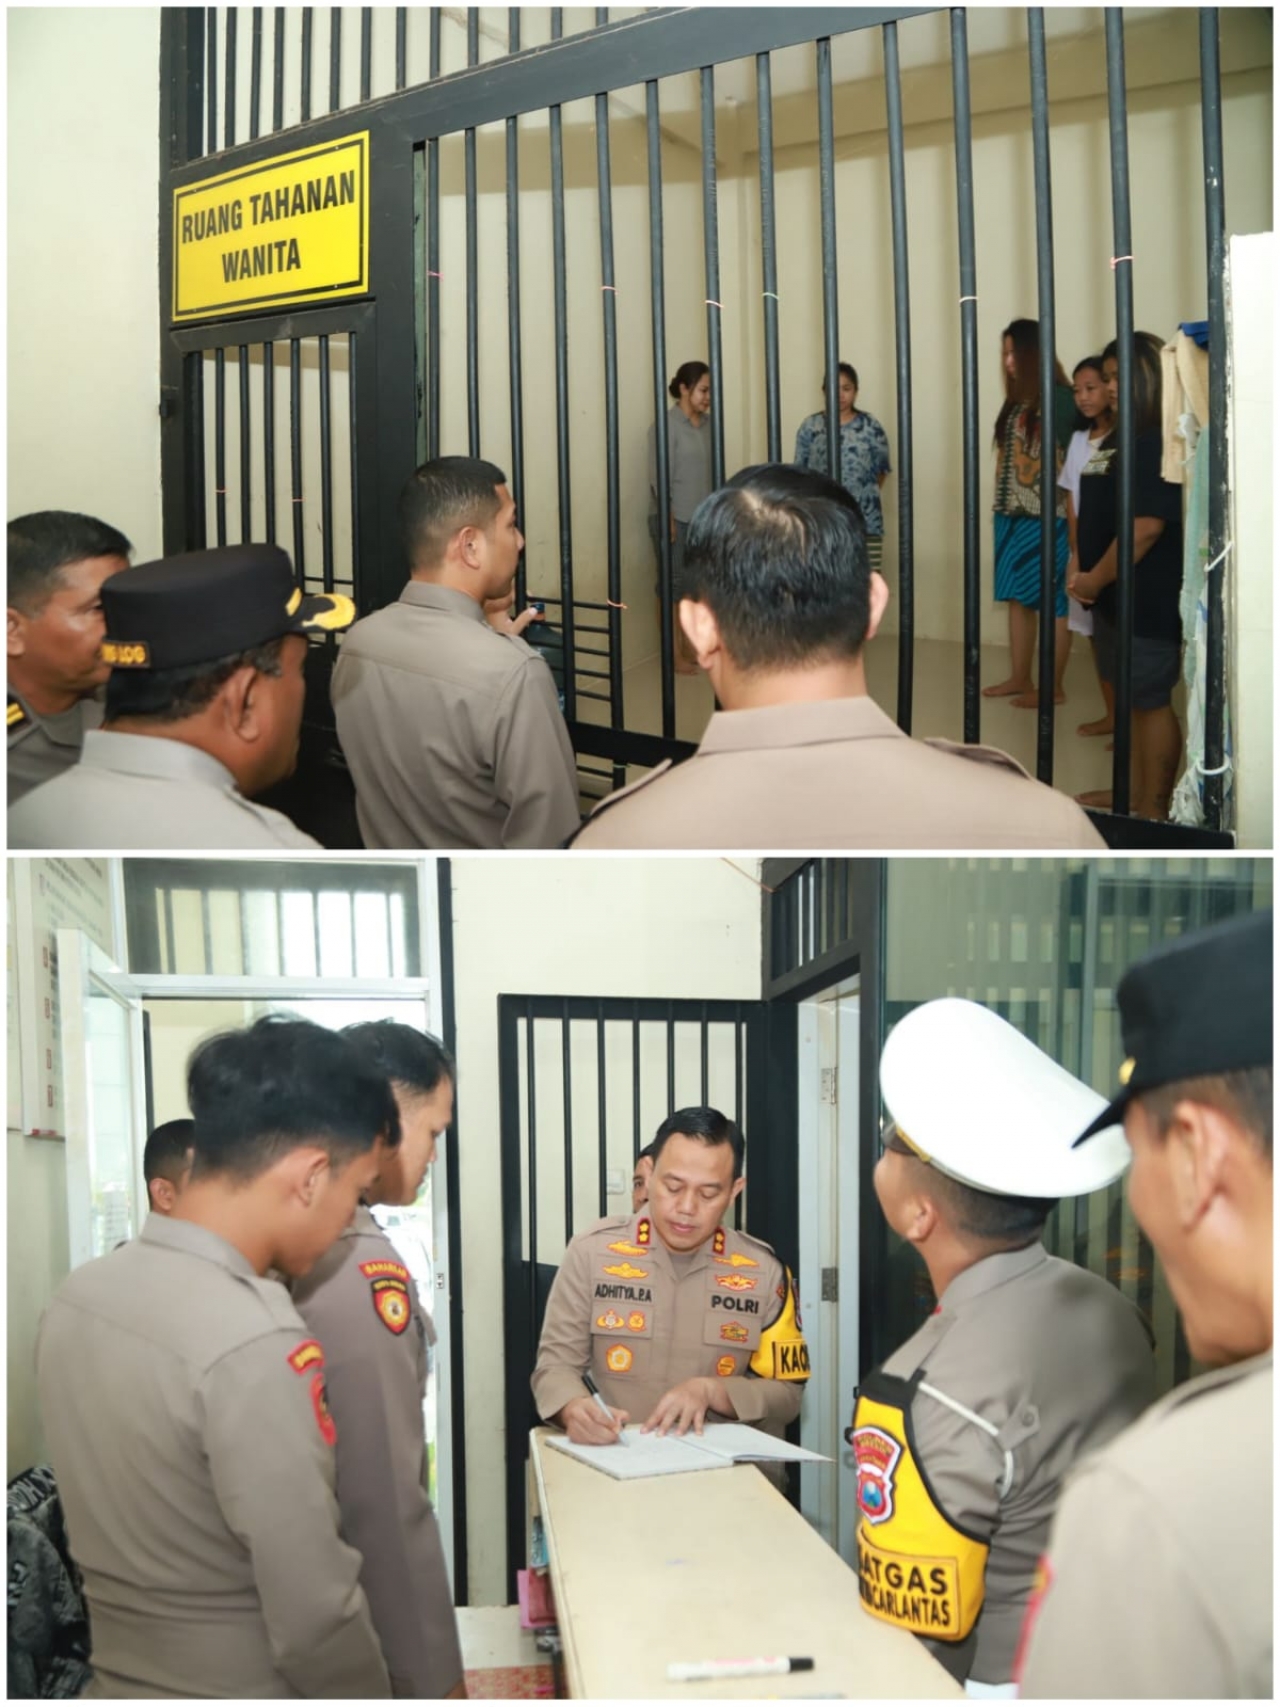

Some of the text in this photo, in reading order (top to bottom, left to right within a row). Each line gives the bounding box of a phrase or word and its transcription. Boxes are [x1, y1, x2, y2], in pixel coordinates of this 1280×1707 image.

[182, 170, 355, 244] RUANG TAHANAN
[222, 238, 301, 283] WANITA
[711, 1295, 759, 1315] POLRI
[860, 1551, 948, 1596] ATGAS
